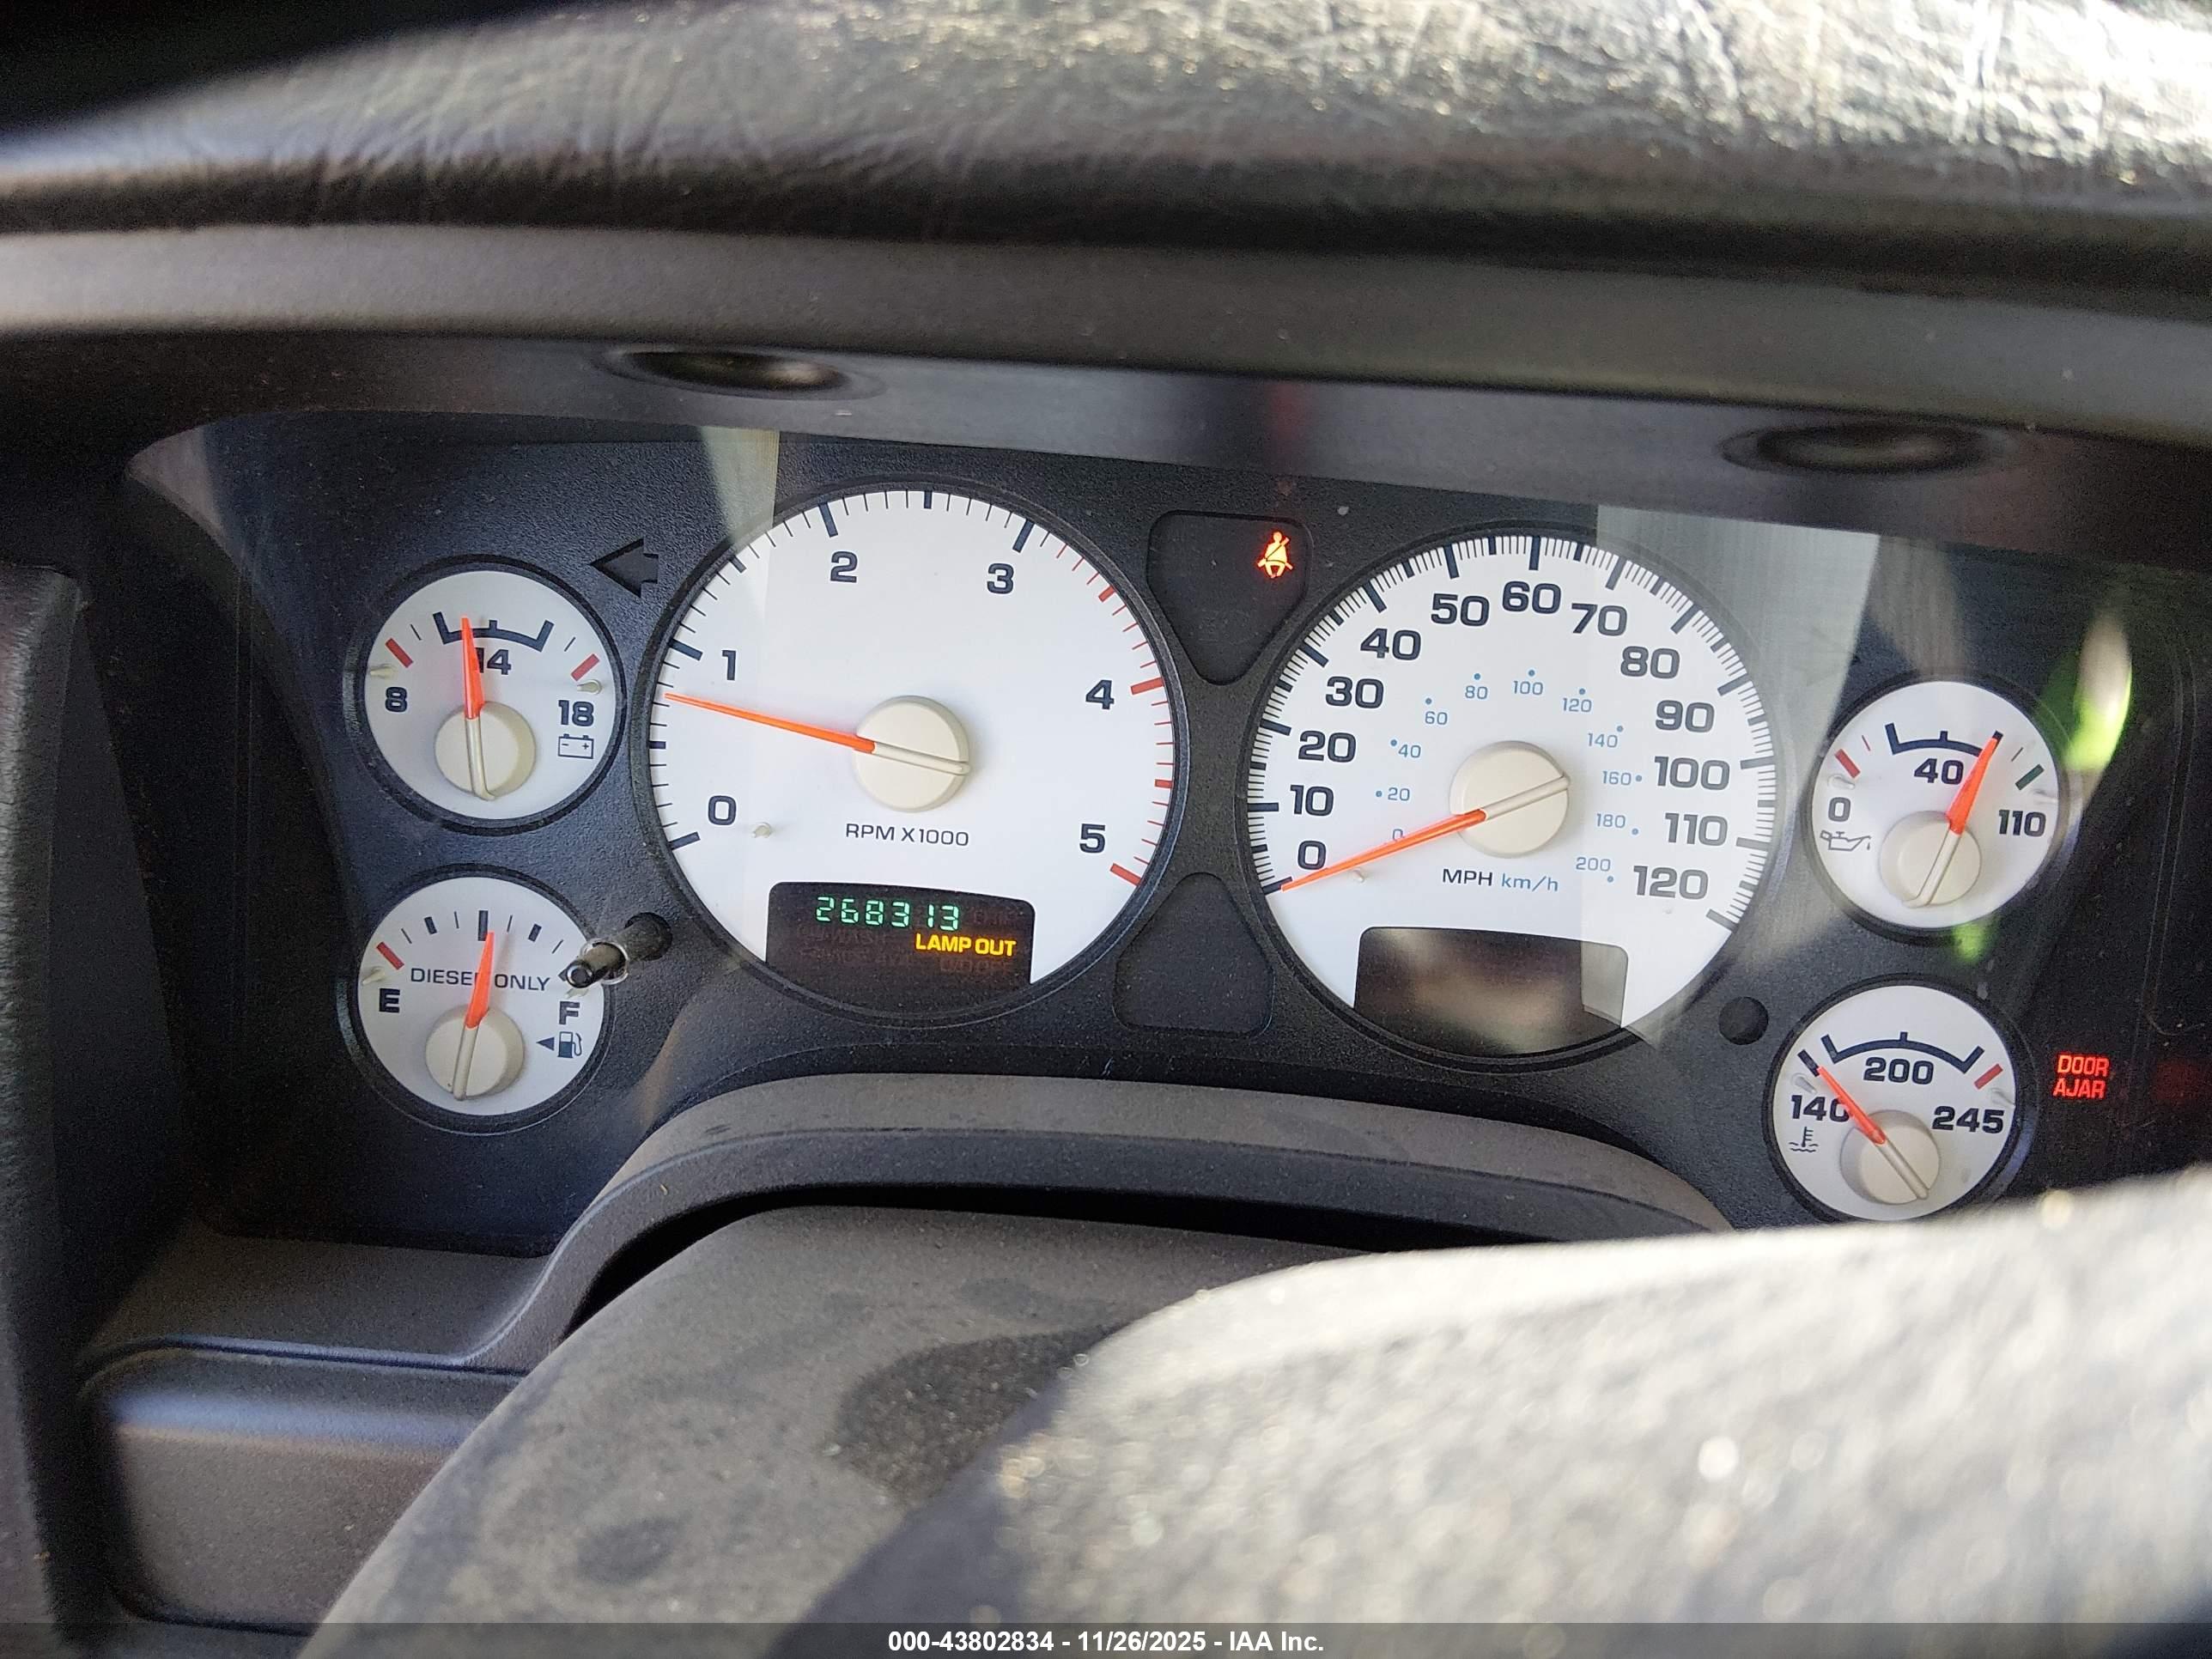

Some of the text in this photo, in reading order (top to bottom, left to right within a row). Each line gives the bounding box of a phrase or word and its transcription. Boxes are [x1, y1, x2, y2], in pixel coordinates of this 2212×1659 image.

[830, 551, 858, 583] 2
[987, 563, 1014, 594] 3
[1431, 593, 1489, 626] 50
[1503, 581, 1561, 614] 60
[1571, 603, 1627, 635] 70
[1360, 629, 1421, 660] 40
[721, 650, 737, 681] 1
[1620, 647, 1680, 678] 80
[386, 687, 407, 712] 8
[1086, 679, 1114, 710] 4
[1326, 677, 1384, 708] 30
[1465, 685, 1487, 700] 80
[1513, 681, 1543, 695] 100
[558, 700, 594, 726] 18
[1425, 711, 1447, 726] 60
[1563, 698, 1592, 713] 120
[1656, 701, 1715, 732] 90
[1298, 731, 1356, 763] 20
[1398, 744, 1421, 758] 40
[1588, 733, 1618, 748] 140
[1602, 771, 1631, 786] 160
[1654, 757, 1729, 791] 100
[1914, 758, 1964, 785] 40
[1290, 785, 1334, 816] 10
[1388, 787, 1409, 801] 20
[708, 795, 736, 825] 0
[1596, 813, 1626, 828] 180
[1828, 798, 1850, 822] 0
[1999, 809, 2045, 837] 110
[845, 823, 969, 847] RPM X1000
[1079, 823, 1106, 854] 5
[1665, 813, 1728, 846] 110
[1297, 841, 1326, 870] 0
[1576, 857, 1611, 872] 200
[1443, 869, 1558, 892] MPH km/h
[1633, 866, 1708, 900] 120
[816, 896, 959, 931] 268313
[915, 933, 1016, 957] LAMP OUT
[495, 974, 550, 991] ONLY
[379, 988, 400, 1012] E
[559, 1001, 580, 1024] F
[1863, 1057, 1934, 1085] 200
[2057, 1054, 2109, 1077] DOOR
[2053, 1078, 2106, 1099] AJAR
[1790, 1095, 1850, 1123] 140
[1932, 1106, 2004, 1134] 245
